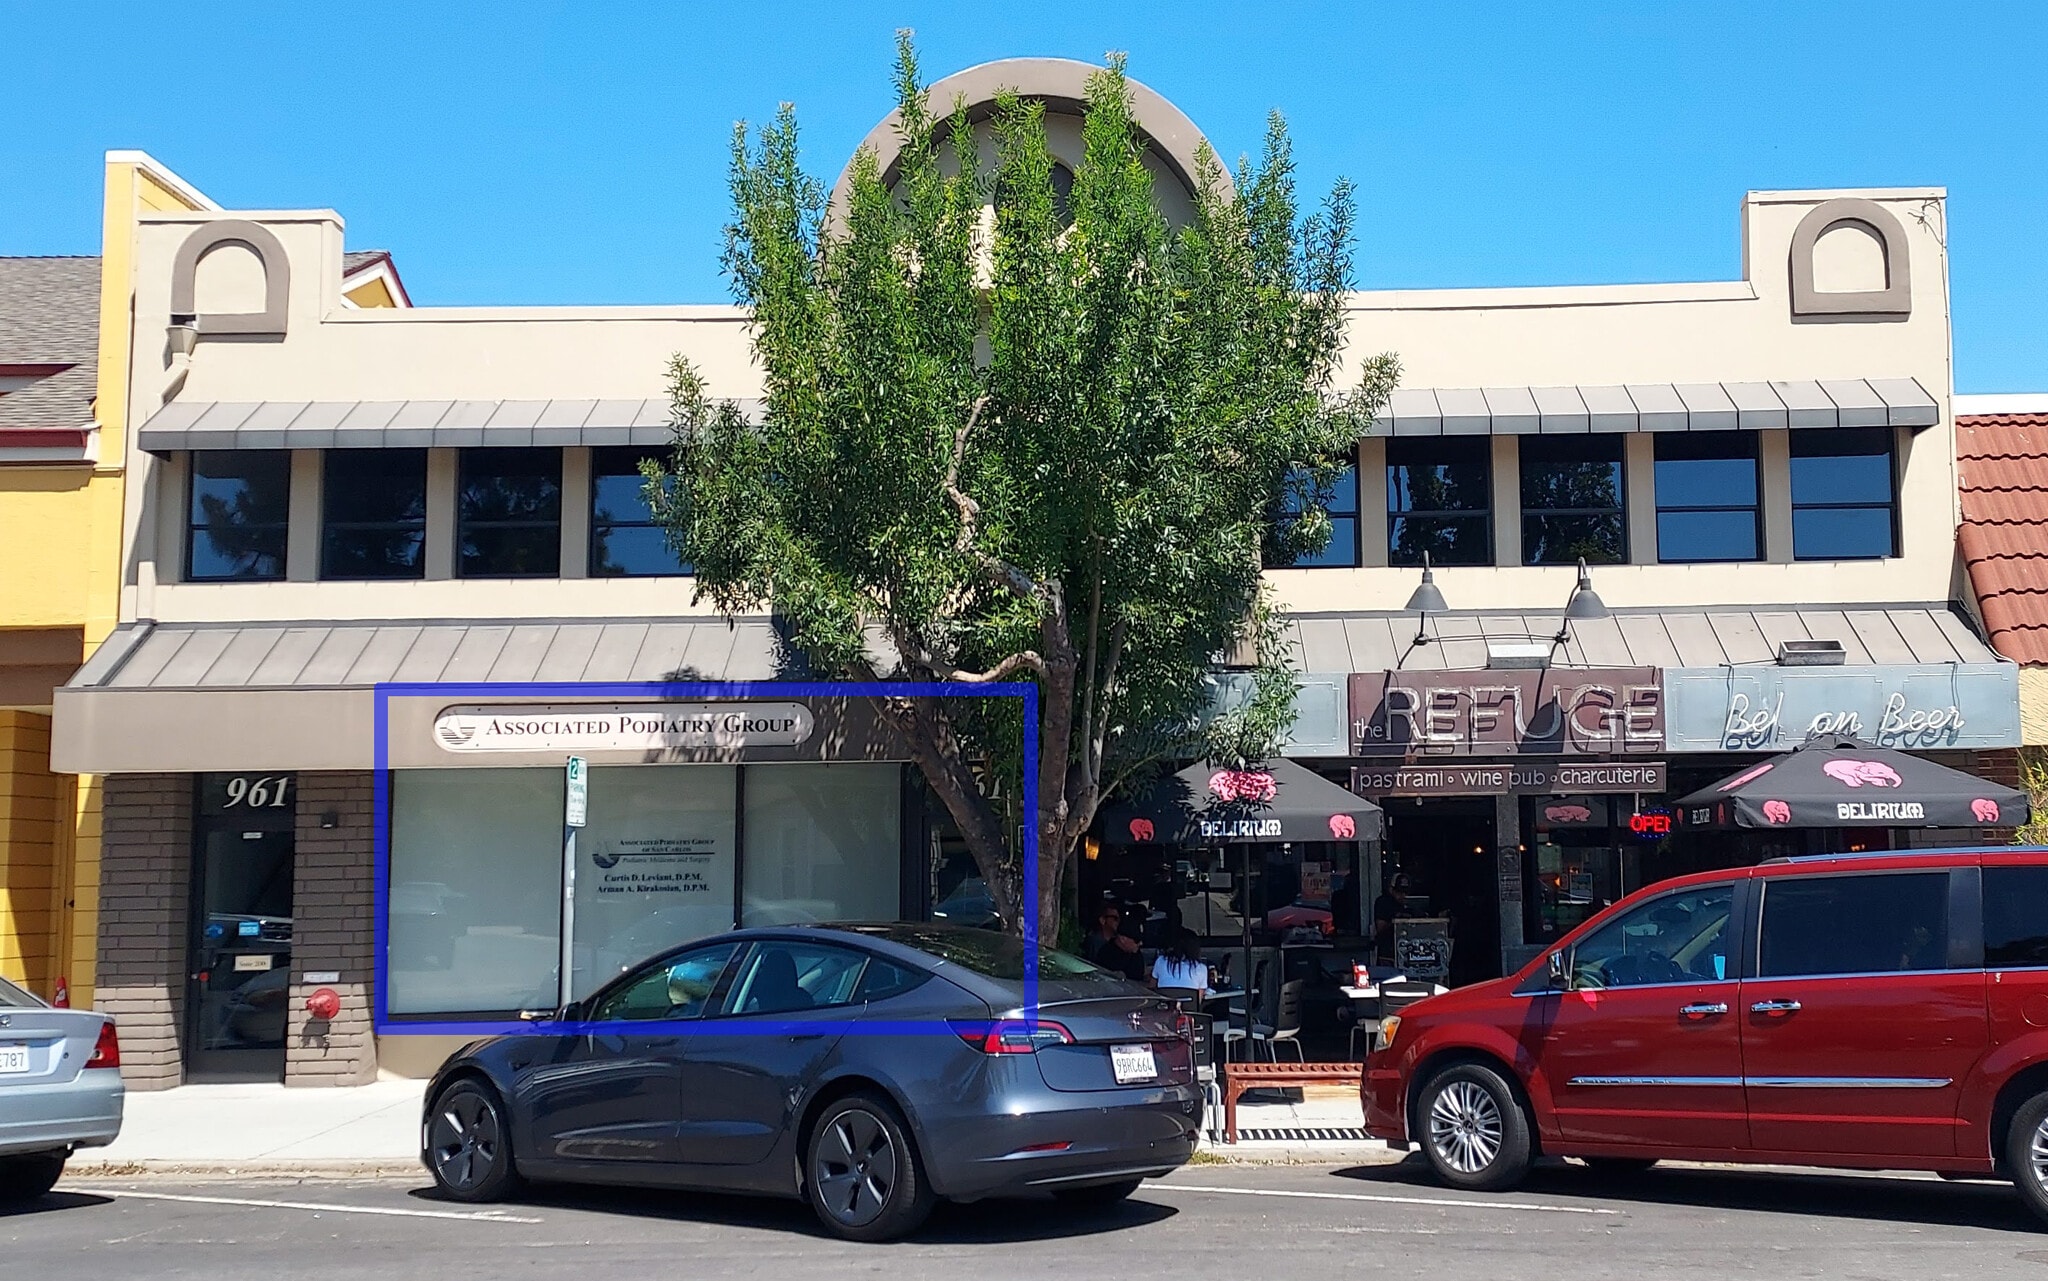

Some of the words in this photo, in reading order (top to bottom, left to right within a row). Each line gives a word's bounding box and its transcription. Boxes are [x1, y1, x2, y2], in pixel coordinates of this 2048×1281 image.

[1353, 718, 1383, 739] the
[1384, 684, 1664, 741] REFUGE
[1881, 692, 1966, 733] Beer
[486, 717, 611, 736] ASSOCIATED
[619, 716, 716, 734] PODIATRY
[724, 715, 795, 733] GROUP
[1359, 770, 1444, 791] pastrami
[1461, 769, 1503, 787] wine
[1508, 767, 1546, 788] pub
[1559, 764, 1657, 786] charcuterie
[222, 776, 289, 809] 961
[1837, 803, 1925, 820] DELIRIUM
[1200, 819, 1282, 837] DELIRIUM
[604, 874, 630, 882] Curtis
[675, 873, 703, 881] D.P.M.
[597, 885, 624, 893] Arman
[626, 885, 635, 893] A.
[683, 884, 710, 892] D.P.M.
[0, 1052, 24, 1067] 787
